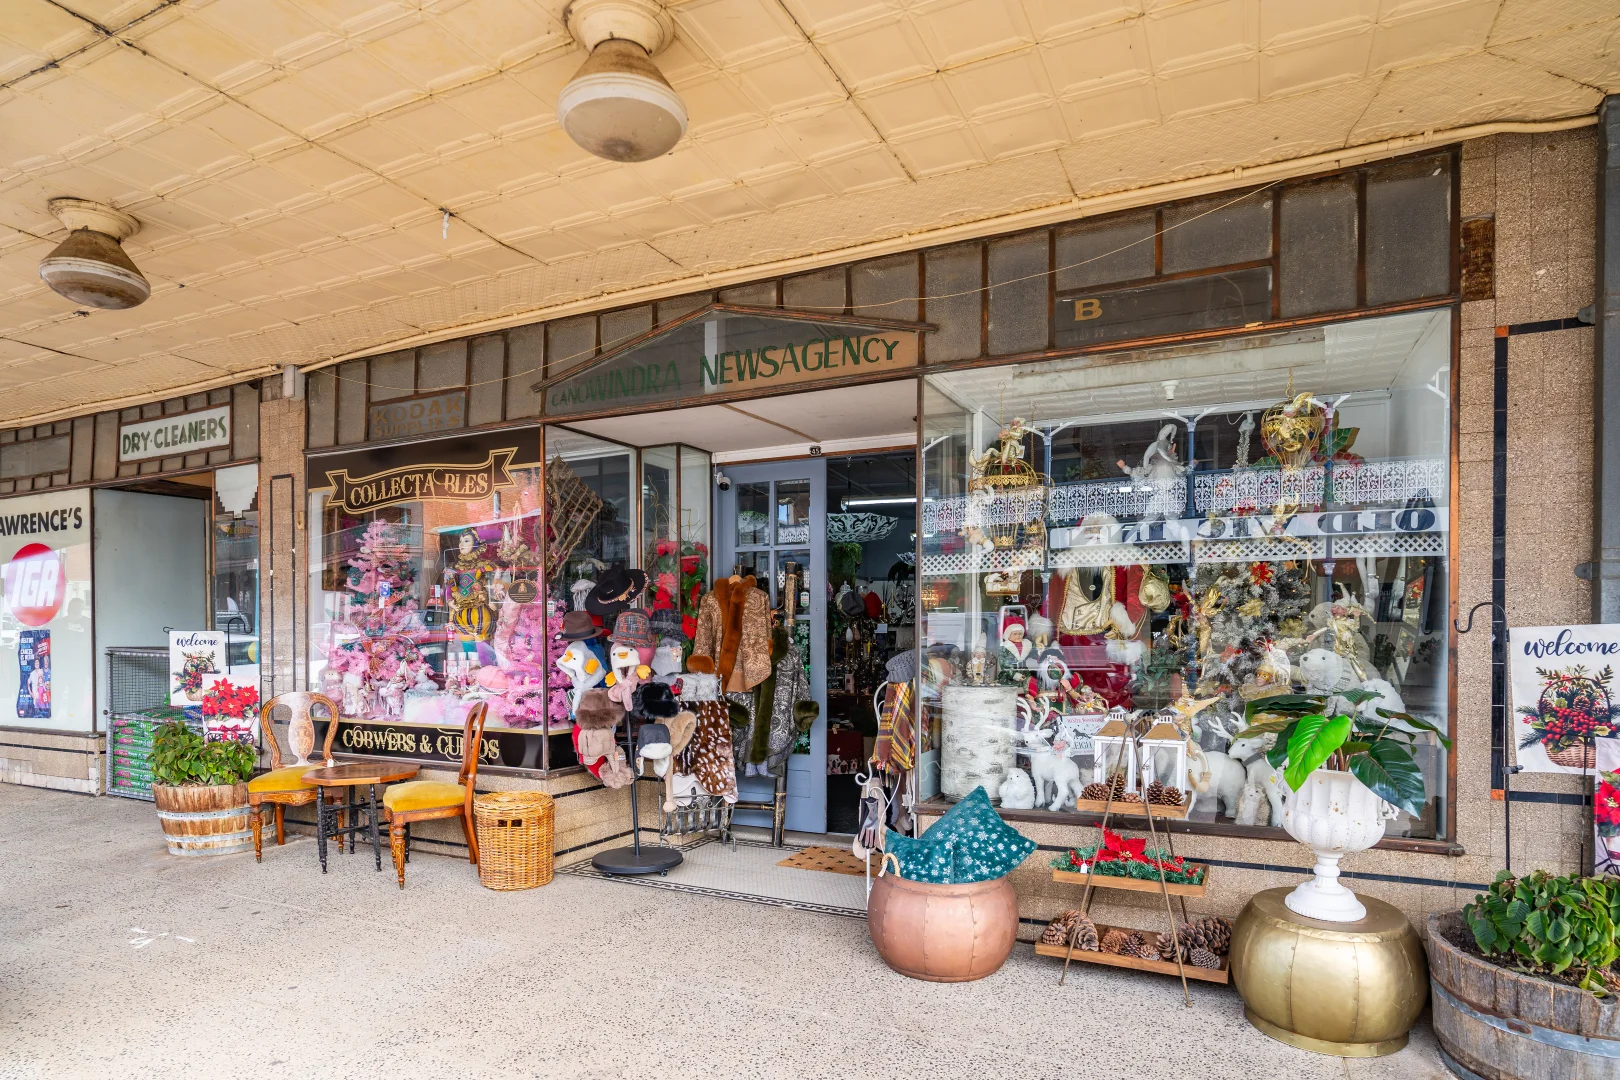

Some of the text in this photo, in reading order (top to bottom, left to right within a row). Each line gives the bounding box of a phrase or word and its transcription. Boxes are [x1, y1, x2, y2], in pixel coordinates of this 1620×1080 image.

[1074, 297, 1103, 322] B
[551, 335, 899, 407] CANOWINDRA NEWSAGENCY
[373, 395, 462, 425] KODAK
[374, 413, 460, 438] SUPPLIES
[350, 467, 489, 506] COLLECTABLES
[11, 559, 59, 607] IGA
[176, 633, 219, 648] welcome
[1524, 628, 1620, 658] welcome
[343, 725, 417, 753] COBWEBS
[419, 734, 433, 753] &
